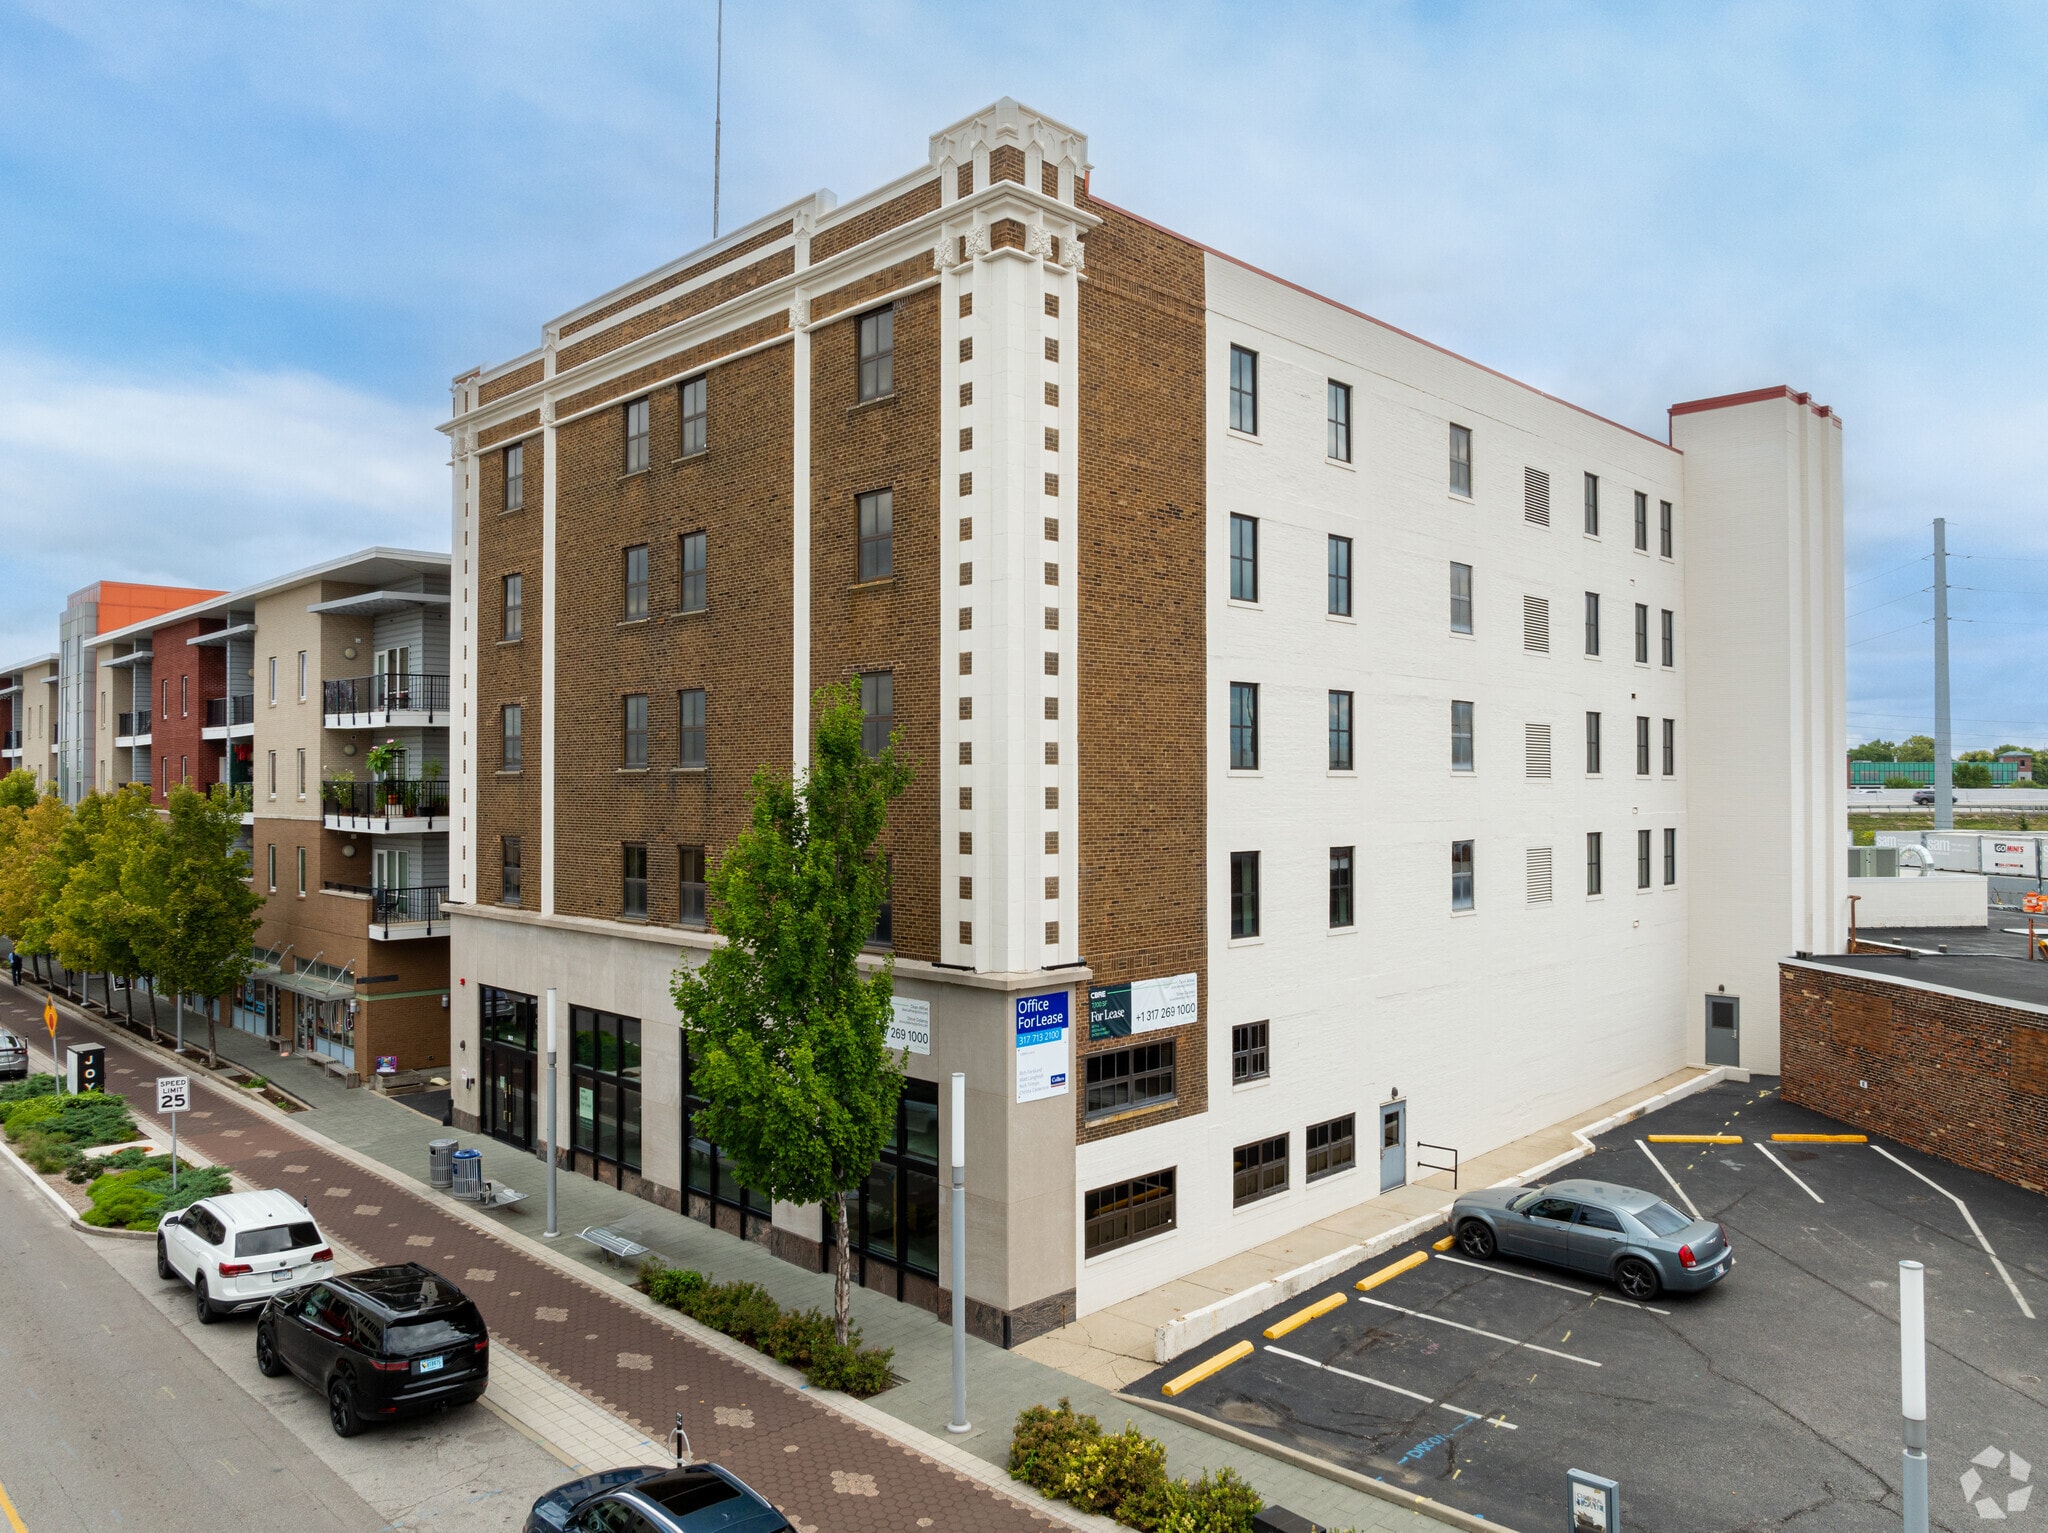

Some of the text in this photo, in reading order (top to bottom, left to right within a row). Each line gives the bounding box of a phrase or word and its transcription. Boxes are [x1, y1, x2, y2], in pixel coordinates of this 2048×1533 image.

[1926, 838, 1950, 851] sam
[1996, 844, 2006, 852] GO
[1018, 998, 1049, 1014] Office
[1136, 1002, 1196, 1022] +1 317 269 1000
[1018, 1013, 1063, 1030] For Lease
[1090, 1009, 1125, 1023] For Lease
[890, 1027, 906, 1040] 269
[907, 1030, 929, 1044] 1000
[1018, 1030, 1060, 1046] 317 713 2100
[84, 1055, 96, 1091] JOY
[160, 1079, 187, 1088] SPEED
[162, 1086, 183, 1094] LIMIT
[161, 1094, 186, 1108] 25
